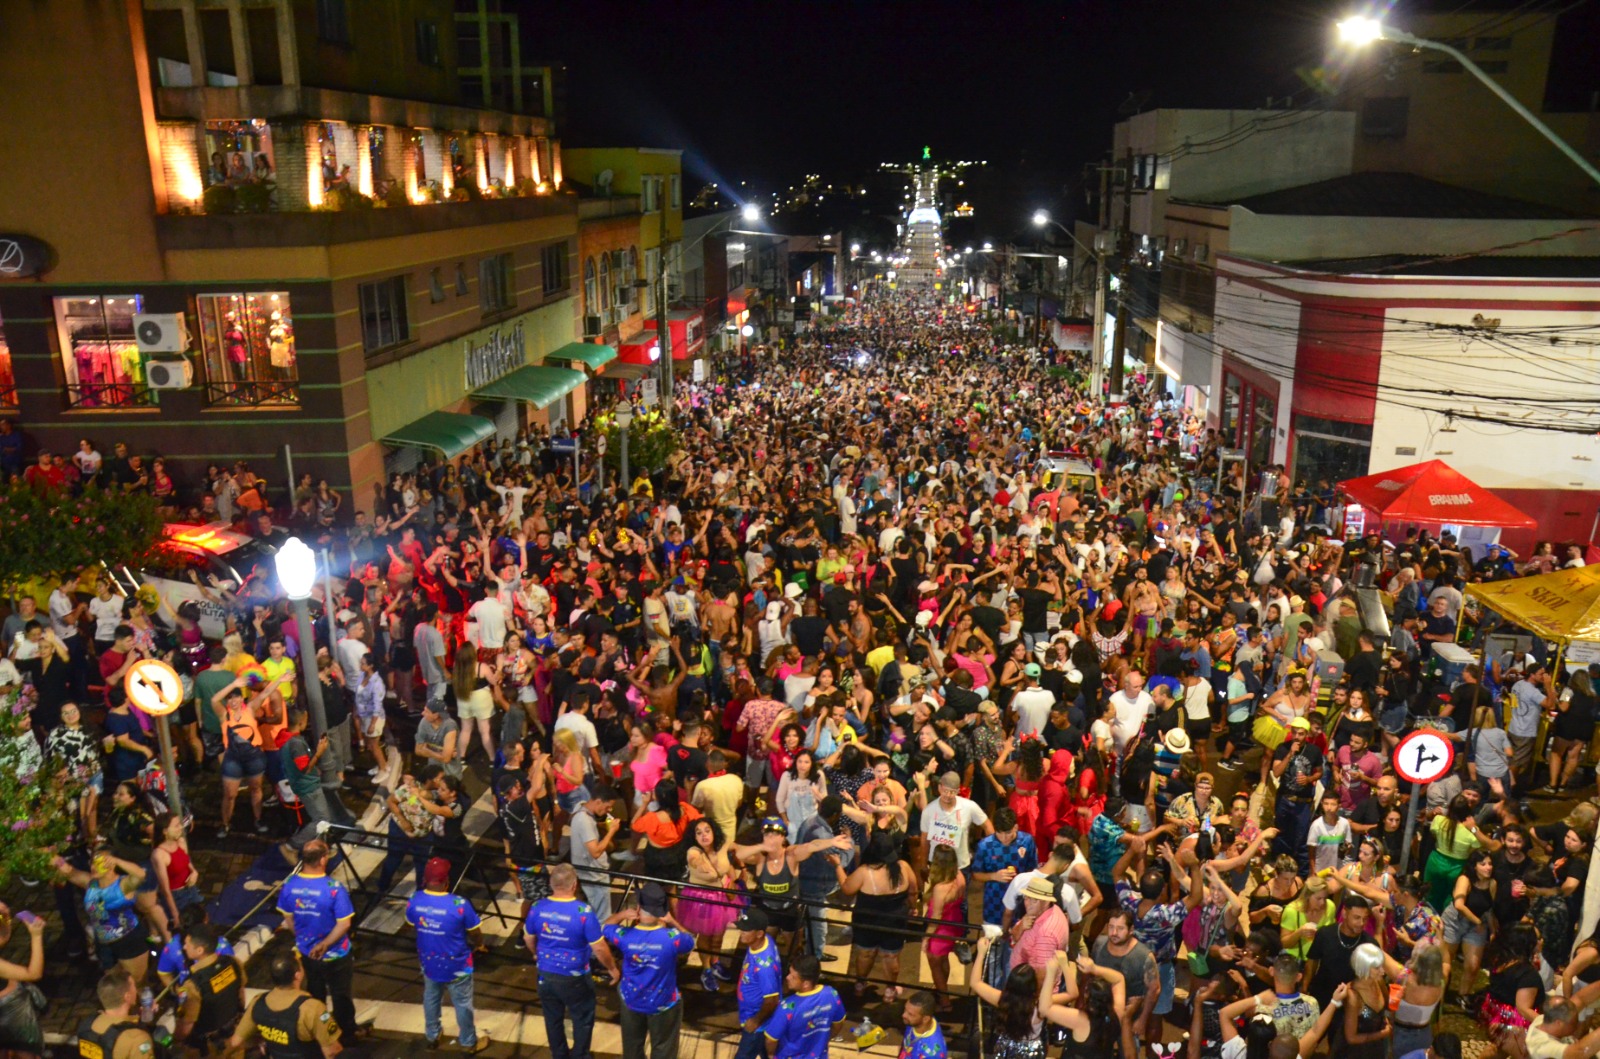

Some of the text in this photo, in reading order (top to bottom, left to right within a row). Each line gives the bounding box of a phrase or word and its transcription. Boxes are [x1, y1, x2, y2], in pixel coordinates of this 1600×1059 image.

[1428, 493, 1474, 506] BRAHMA
[1525, 586, 1571, 612] SKOL
[934, 821, 959, 832] MOVIDO
[1273, 1003, 1313, 1019] BRASIL
[257, 1024, 289, 1038] POLÍCIA
